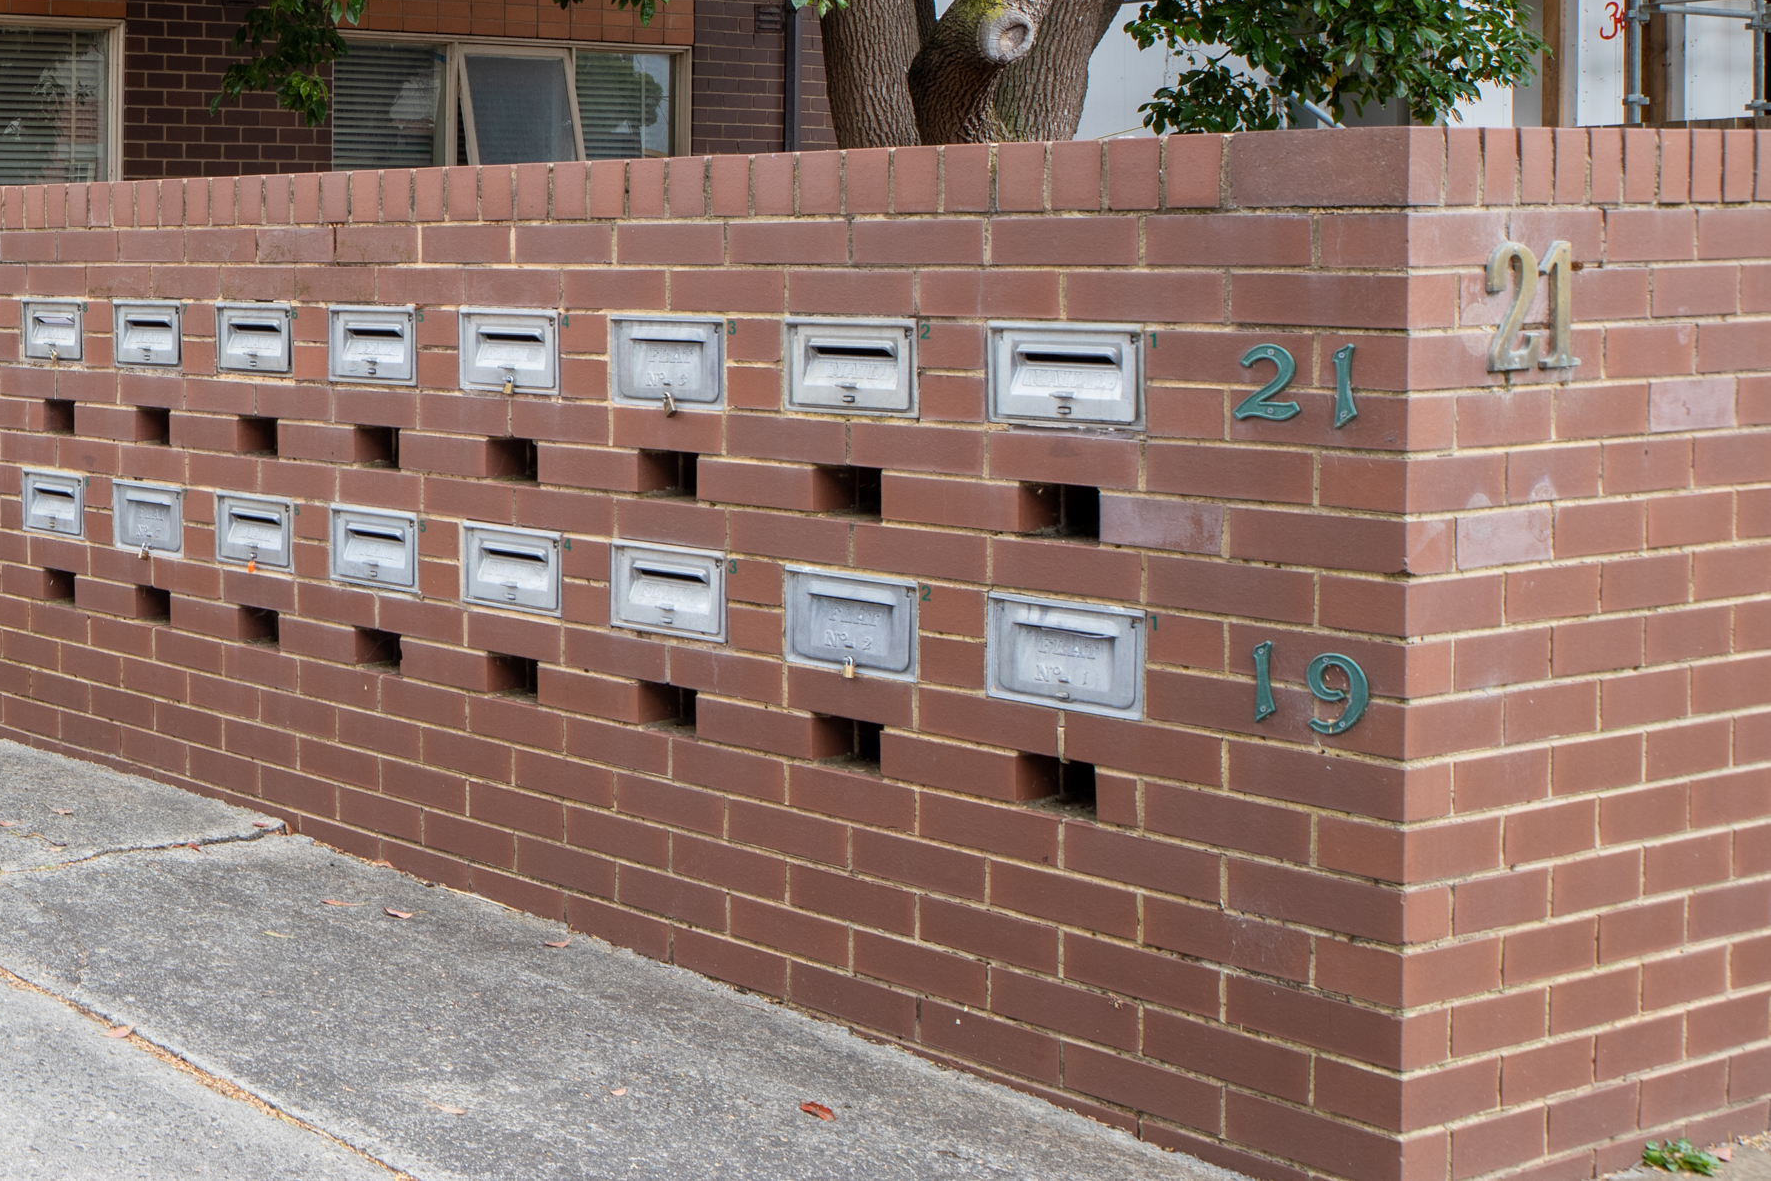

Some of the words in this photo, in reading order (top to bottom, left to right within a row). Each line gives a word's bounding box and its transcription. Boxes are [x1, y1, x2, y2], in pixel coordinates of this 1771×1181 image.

[83, 302, 88, 313] 8
[182, 304, 188, 315] 7
[291, 308, 298, 319] 6
[1483, 239, 1582, 374] 21
[417, 309, 424, 322] 5
[561, 315, 570, 329] 4
[728, 320, 736, 335] 3
[920, 324, 930, 339] 2
[1148, 332, 1157, 349] 1
[1232, 342, 1358, 429] 21
[84, 476, 90, 487] 8
[183, 489, 188, 500] 7
[294, 504, 300, 516] 6
[419, 519, 426, 533] 5
[563, 538, 572, 552] 4
[728, 559, 737, 574] 3
[921, 585, 931, 602] 2
[1149, 615, 1158, 631] 1
[1037, 636, 1100, 660] FLAT
[1250, 639, 1371, 735] 19
